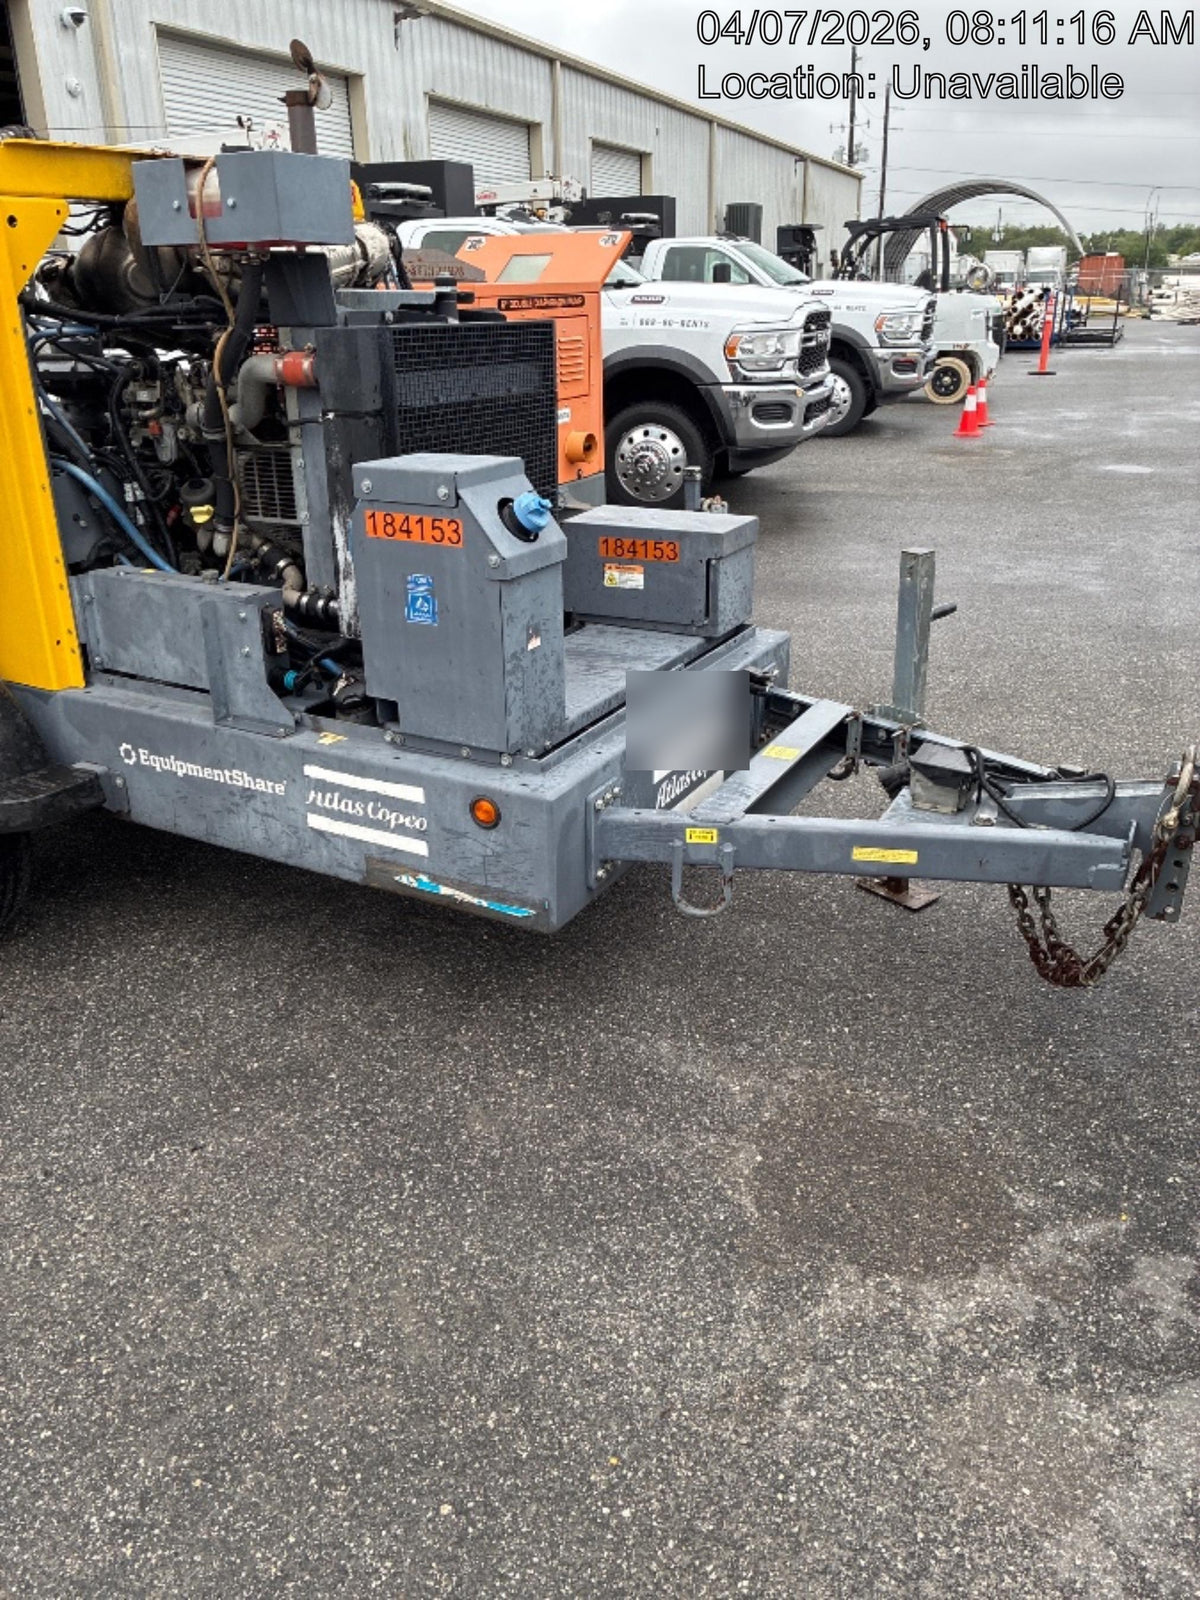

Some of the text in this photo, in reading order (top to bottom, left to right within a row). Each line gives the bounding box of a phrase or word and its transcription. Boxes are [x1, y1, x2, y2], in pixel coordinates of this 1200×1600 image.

[368, 511, 461, 545] 184153
[602, 537, 678, 561] 184153
[138, 748, 286, 796] EquipmentShare
[305, 789, 428, 831] Atlas Copco
